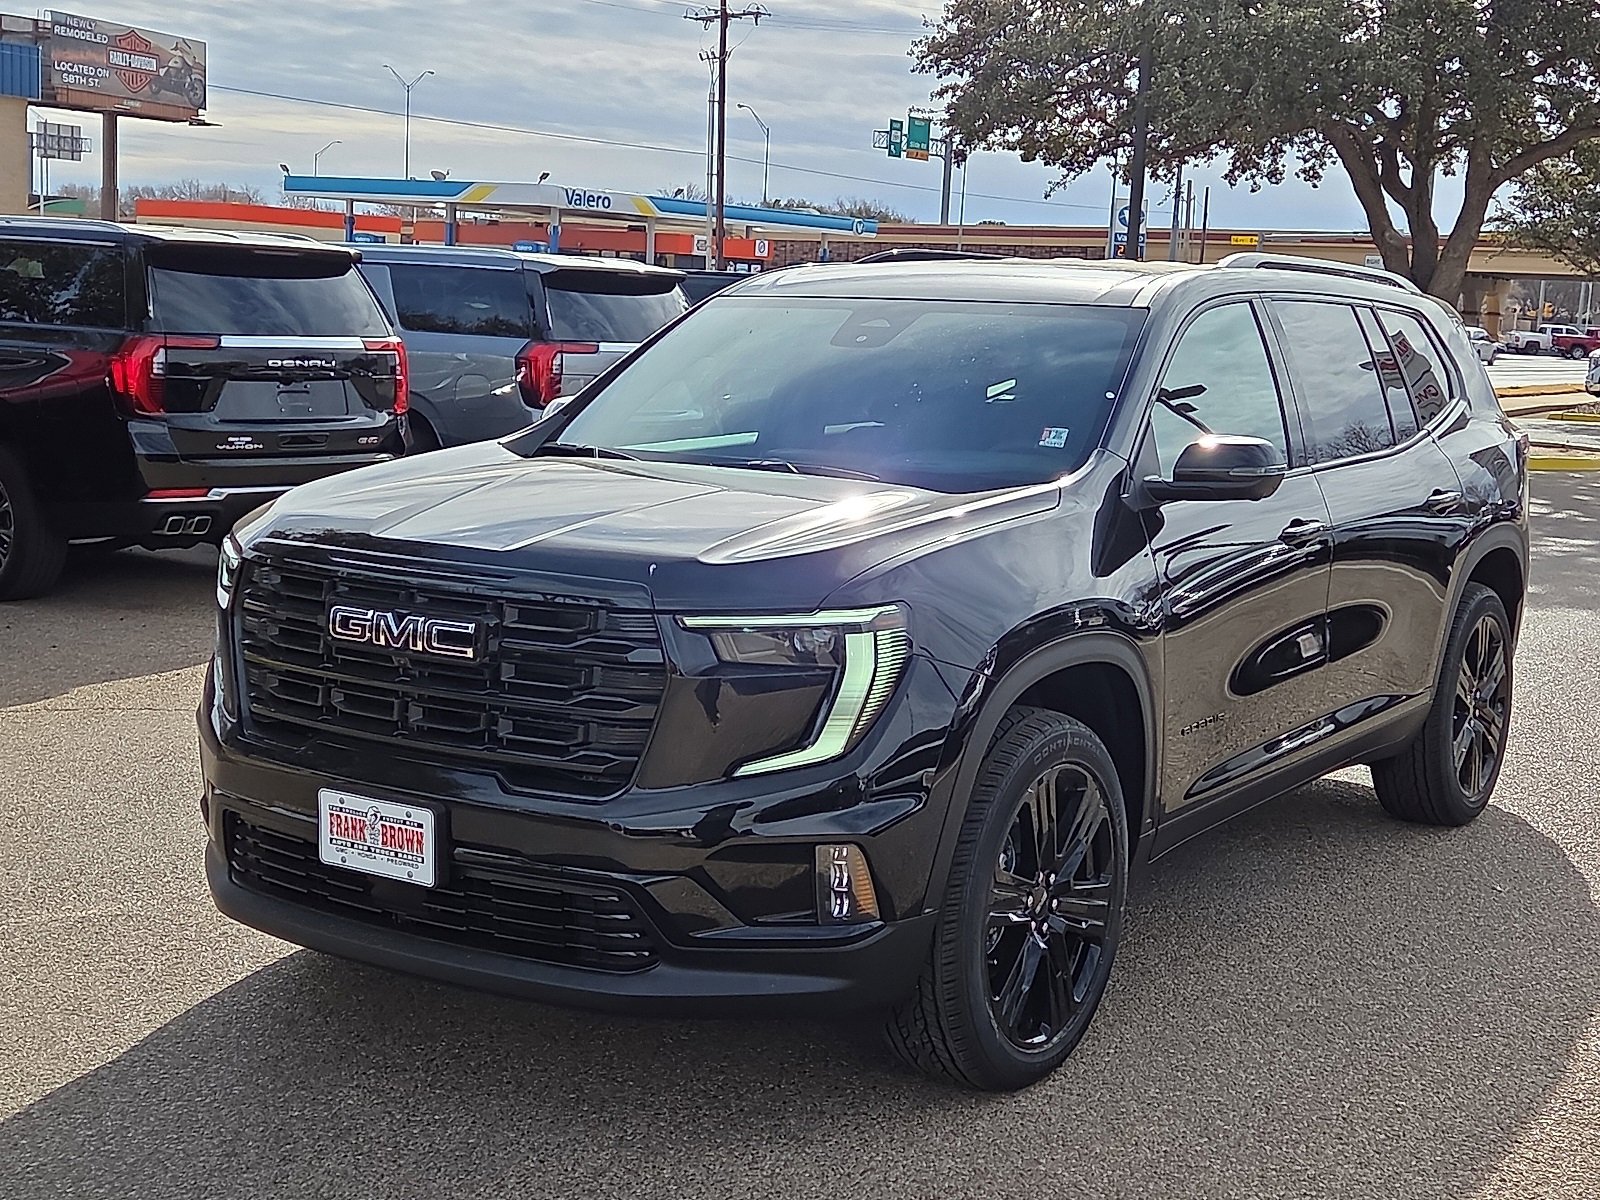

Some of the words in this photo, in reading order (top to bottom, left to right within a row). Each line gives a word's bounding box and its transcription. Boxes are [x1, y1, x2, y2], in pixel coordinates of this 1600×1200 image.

[66, 16, 97, 30] NEWLY
[54, 25, 108, 43] REMODELED
[54, 60, 96, 76] LOCATED
[96, 68, 110, 79] ON
[62, 72, 87, 85] 58TH
[88, 78, 101, 88] ST.
[565, 188, 611, 209] Valero
[1116, 233, 1144, 242] Vao
[267, 359, 336, 368] DENALI
[329, 605, 476, 659] GMC
[329, 812, 367, 843] FRANK
[381, 823, 424, 855] BROWN
[331, 838, 352, 848] AUTO
